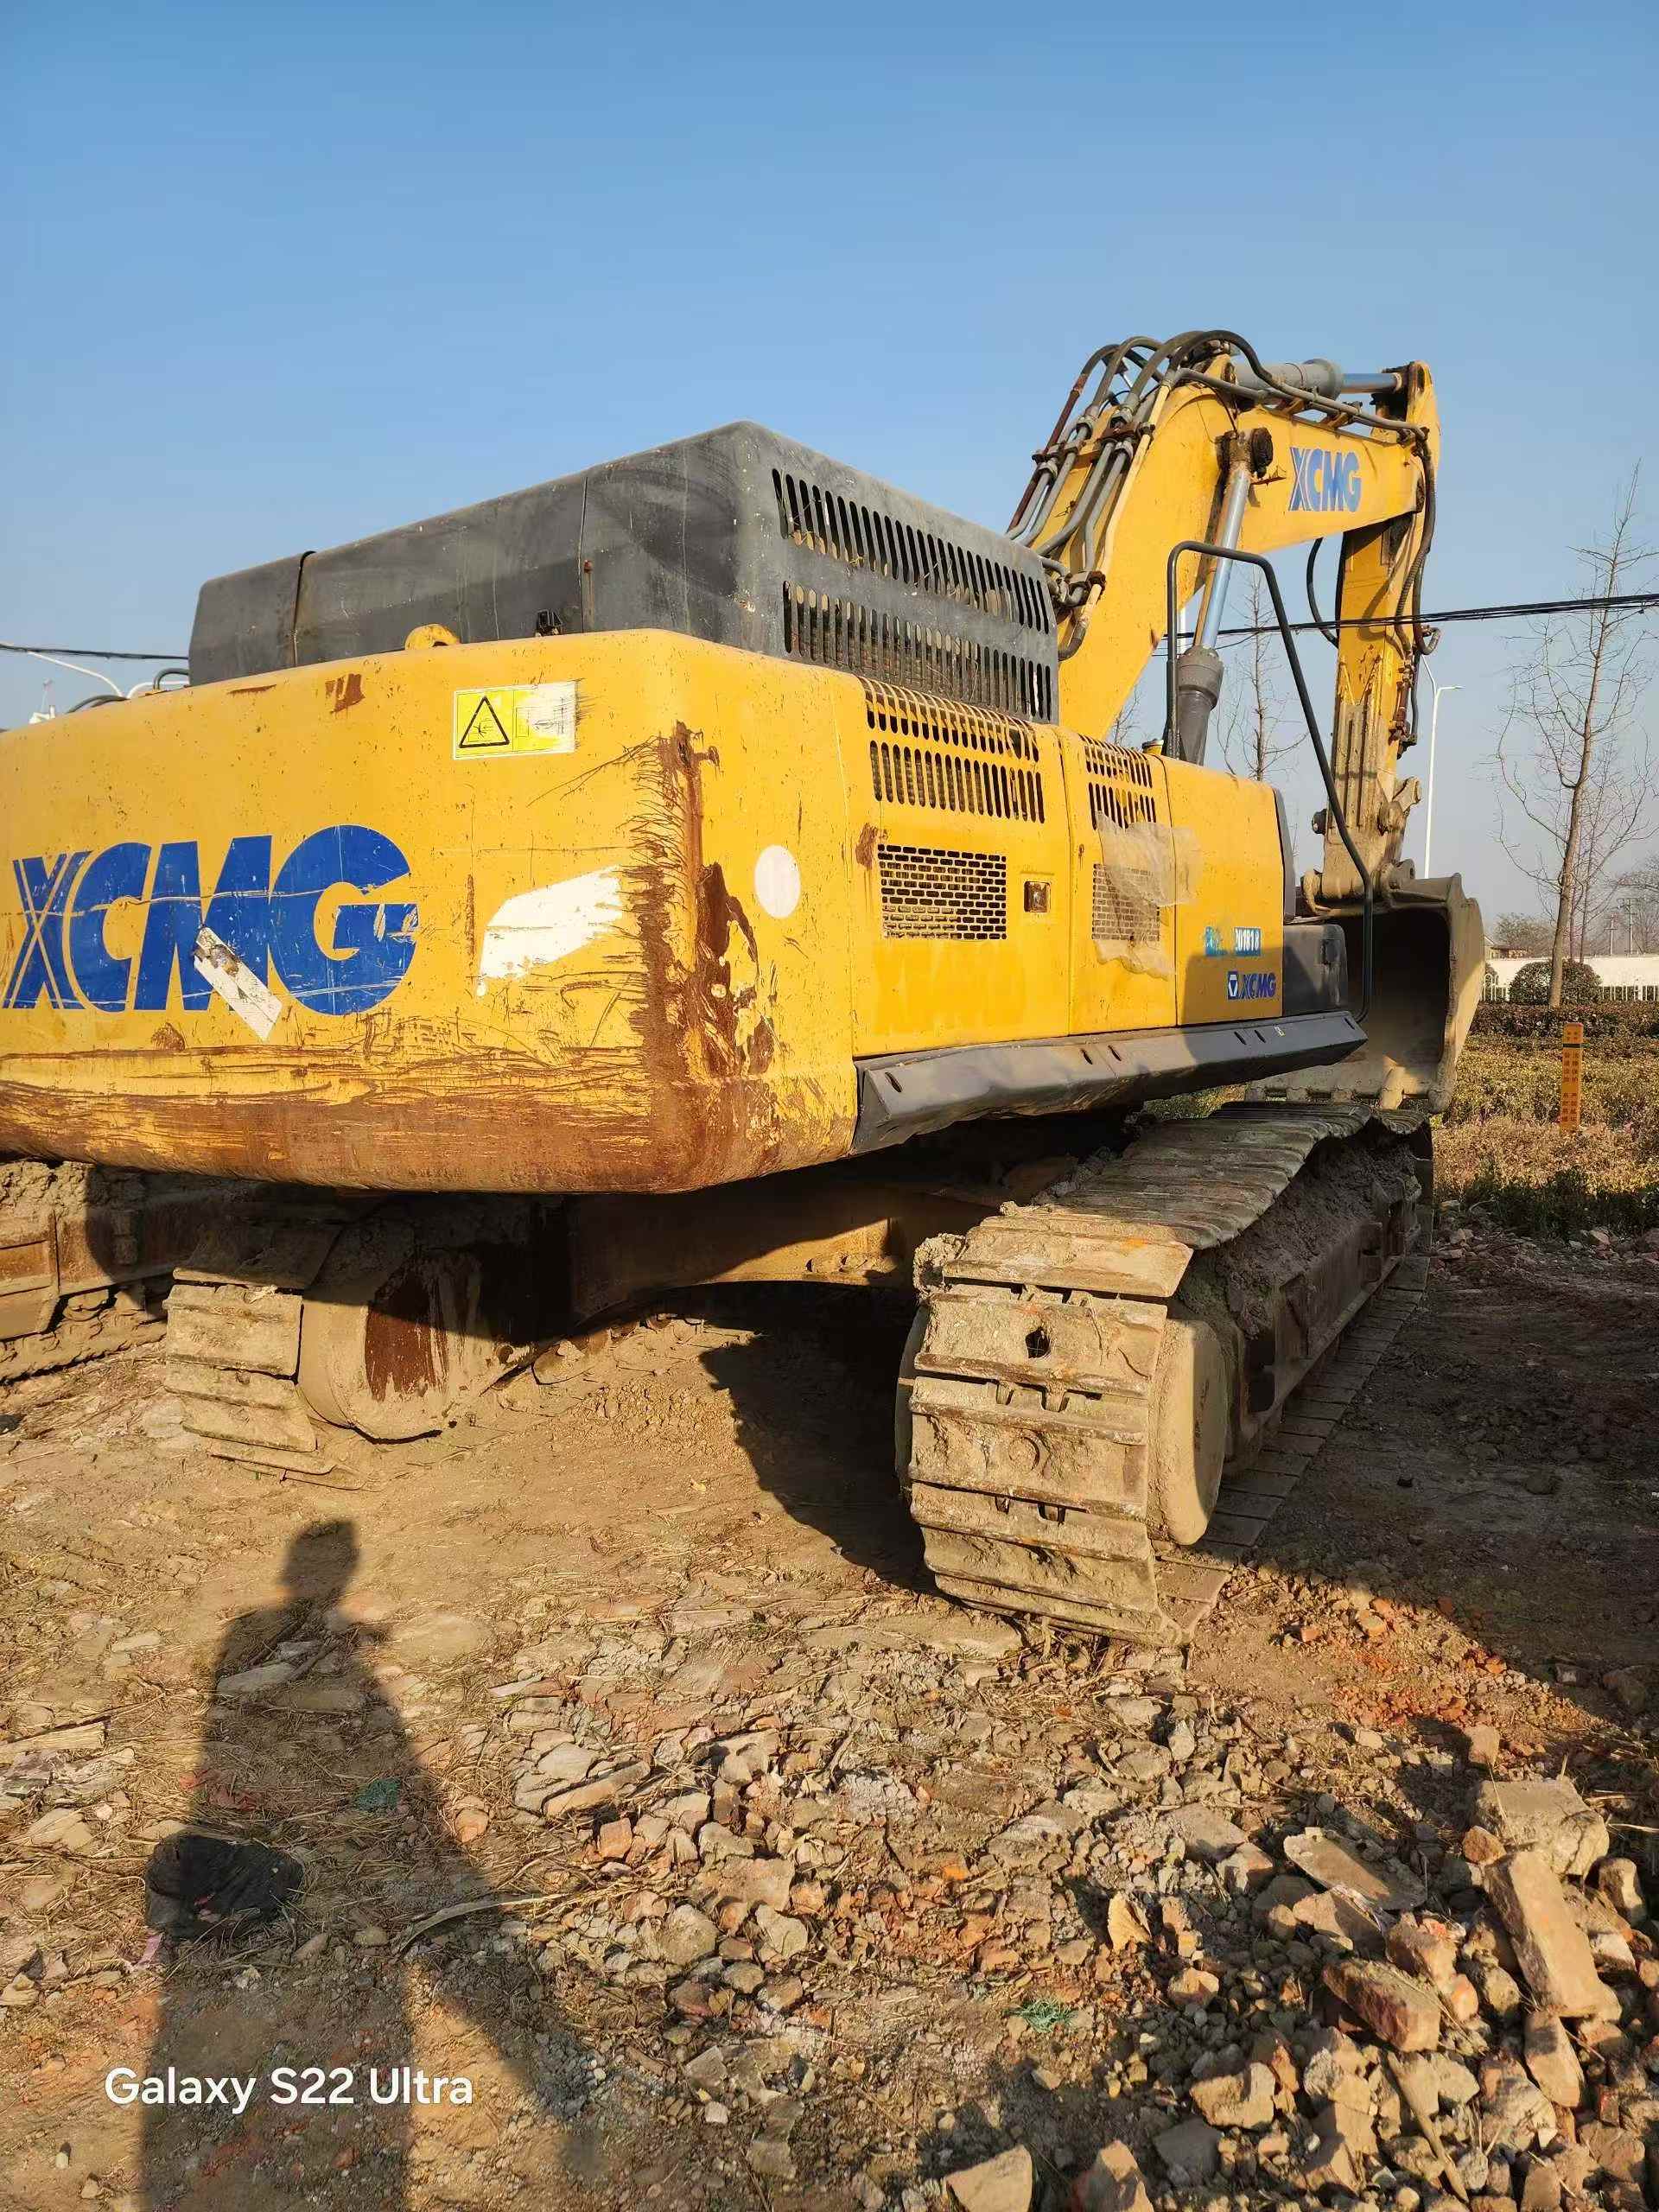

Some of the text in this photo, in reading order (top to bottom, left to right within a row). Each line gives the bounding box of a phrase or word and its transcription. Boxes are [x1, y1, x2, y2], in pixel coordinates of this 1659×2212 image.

[1288, 447, 1362, 512] XCMG
[2, 823, 421, 1016] XCMG
[1238, 972, 1277, 1000] XCMG
